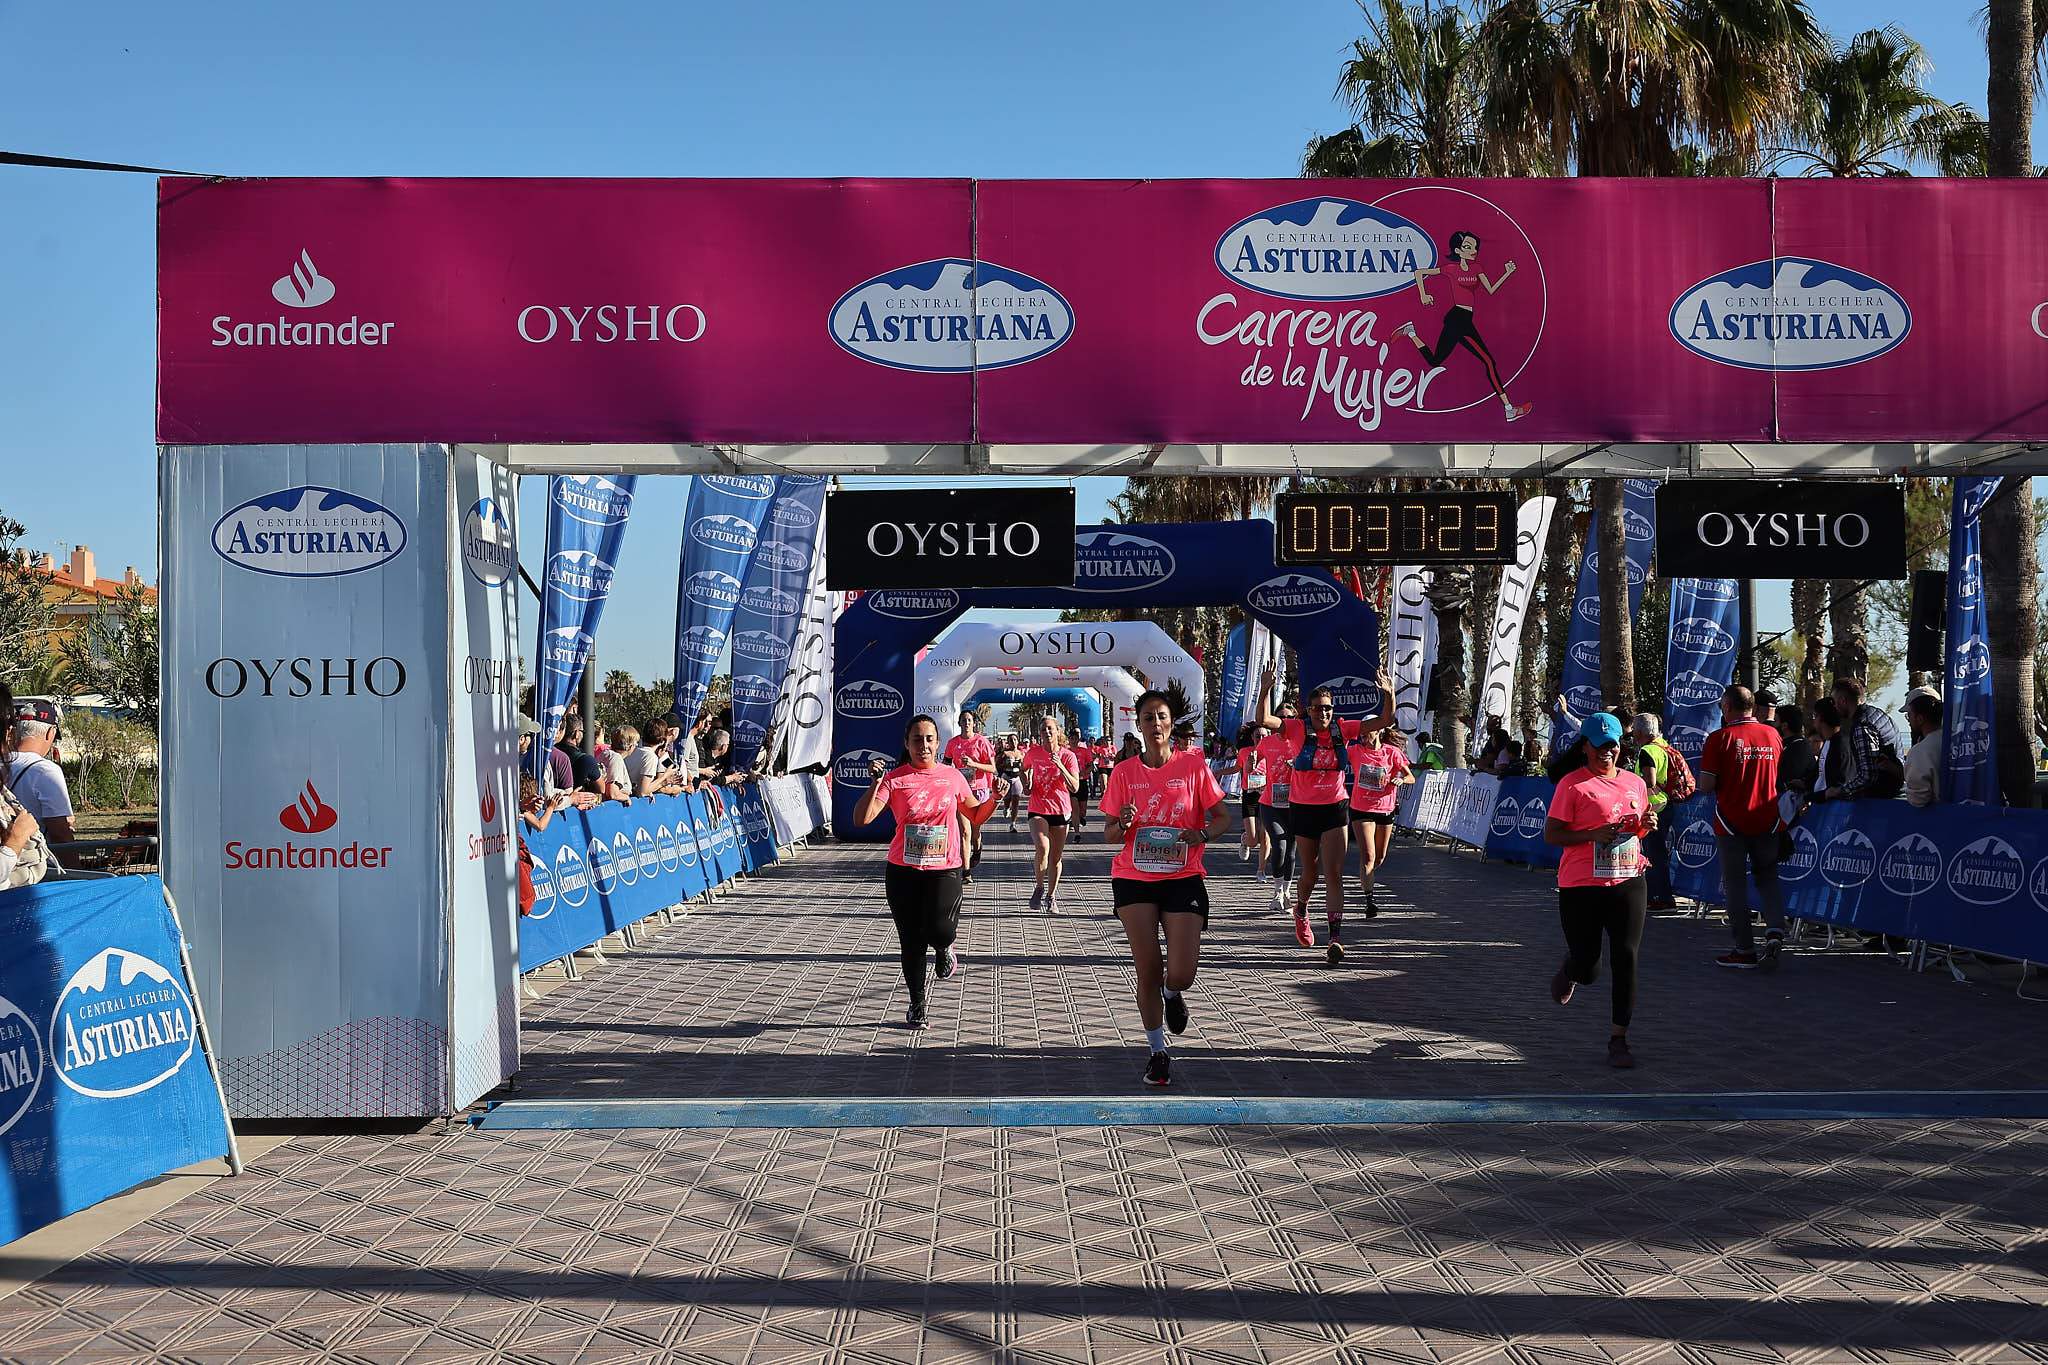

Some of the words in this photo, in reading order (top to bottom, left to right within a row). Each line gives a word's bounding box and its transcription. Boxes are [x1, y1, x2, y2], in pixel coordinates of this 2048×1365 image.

[1266, 233, 1335, 243] CENTRAL
[1343, 233, 1413, 243] LECHERA
[1232, 235, 1417, 273] ASTURIANA
[885, 298, 961, 309] CENTRAL
[1725, 296, 1799, 307] CENTRAL
[1807, 296, 1884, 307] LECHERA
[211, 316, 396, 346] Santander
[517, 304, 707, 344] OYSHO
[848, 301, 1056, 342] ASTURIANA
[1196, 293, 1378, 347] Carrera
[1688, 299, 1893, 340] ASTURIANA
[1240, 350, 1274, 386] de
[1282, 349, 1306, 386] la
[1300, 343, 1448, 431] Mujer
[256, 517, 318, 527] CENTRAL
[324, 517, 386, 527] LECHERA
[1293, 506, 1498, 552] 00:37:23
[1696, 511, 1871, 549] OYSHO
[227, 520, 392, 554] ASTURIANA
[866, 521, 1041, 557] OYSHO
[1112, 549, 1160, 557] LECHERA
[1075, 559, 1165, 577] TURIANA
[874, 592, 952, 609] ASTURIANA
[1255, 591, 1336, 608] ASTURIANA
[999, 631, 1116, 655] OYSHO
[930, 658, 965, 667] OYSHO
[1148, 655, 1183, 664] OYSHO
[205, 656, 408, 698] OYSHO
[464, 655, 513, 697] OYSHO
[1227, 655, 1247, 708] Marlene
[838, 694, 899, 710] ASTURIANA
[915, 705, 947, 714] OYSHO
[1333, 692, 1377, 706] TURIANA
[225, 840, 393, 869] Santander
[1822, 848, 1871, 875] ASTURIANA
[1882, 854, 1936, 881] ASTURIANA
[1951, 859, 2017, 890] ASTURIANA
[79, 998, 126, 1019] CENTRAL
[129, 990, 178, 1009] LECHERA
[64, 1007, 190, 1072] ASTURIANA
